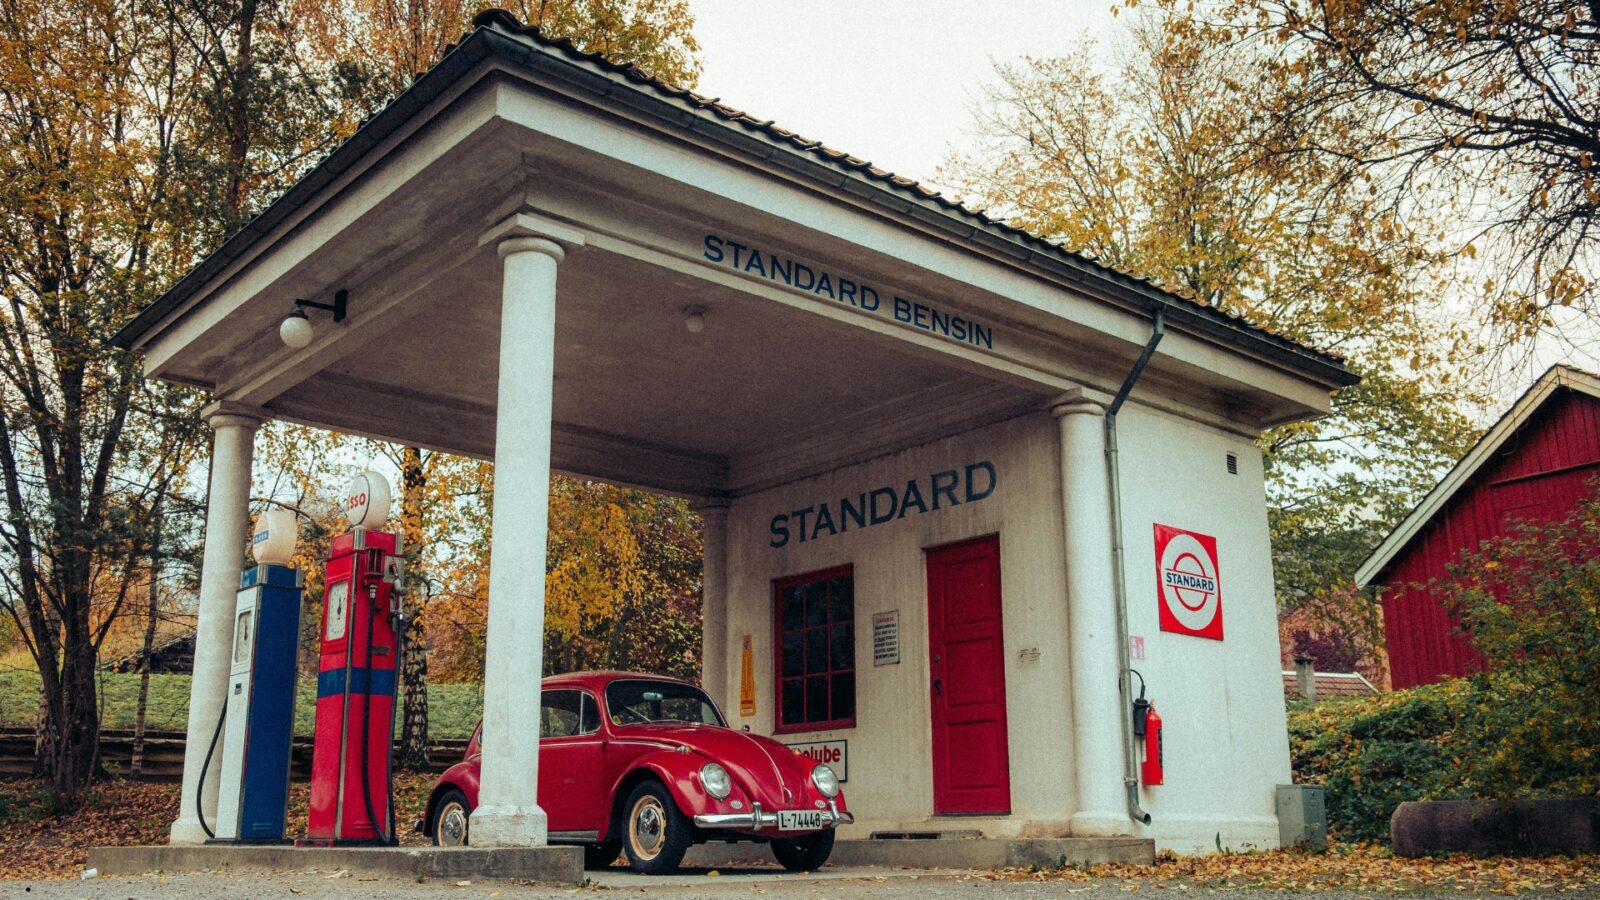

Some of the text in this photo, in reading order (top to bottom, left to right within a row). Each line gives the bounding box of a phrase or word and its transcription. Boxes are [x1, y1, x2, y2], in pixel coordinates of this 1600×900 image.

[703, 234, 993, 349] STANDARD BENSIN
[347, 492, 366, 510] SSO
[769, 460, 998, 549] STANDARD
[1166, 572, 1214, 591] STANDARD
[792, 744, 841, 763] olube
[780, 812, 821, 828] L-74448
